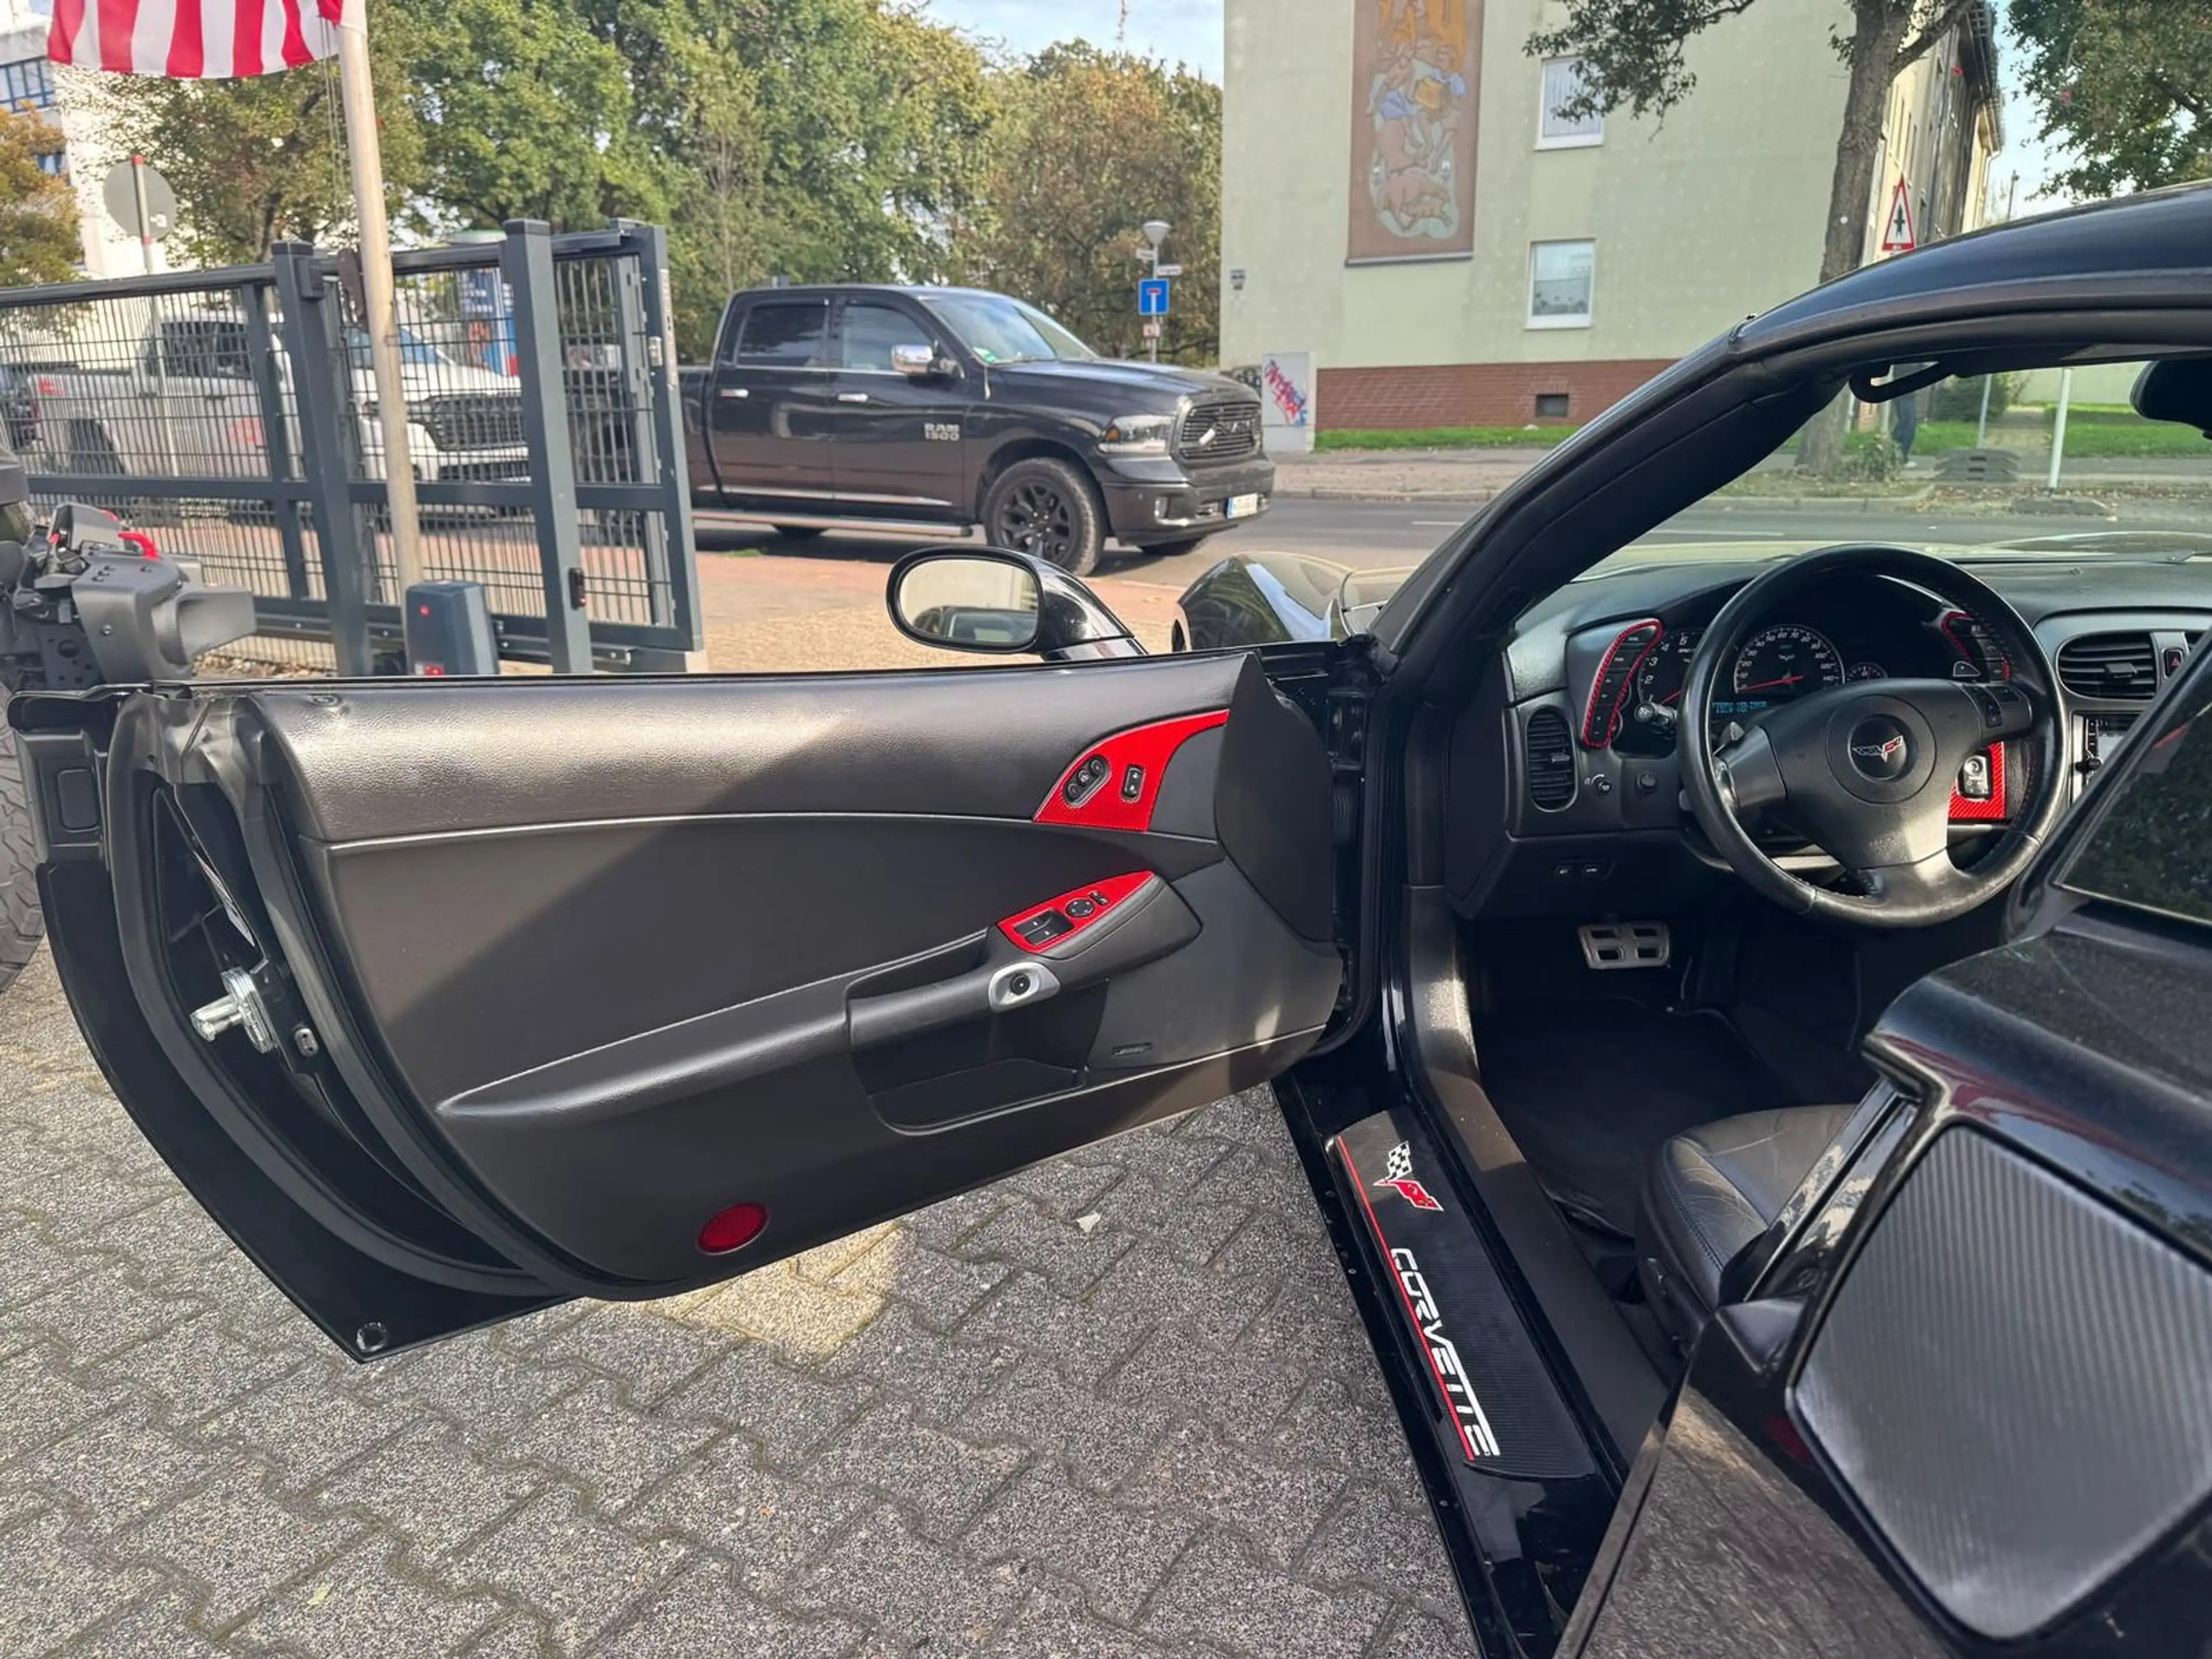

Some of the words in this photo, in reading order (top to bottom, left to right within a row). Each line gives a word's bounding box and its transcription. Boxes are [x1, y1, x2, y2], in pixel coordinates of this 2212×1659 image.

[924, 422, 960, 431] RAM
[925, 431, 960, 441] 1500
[1661, 643, 1669, 652] 4
[1649, 656, 1658, 666] 3
[1644, 675, 1654, 684] 2
[1390, 1248, 1501, 1456] CORVETTE
